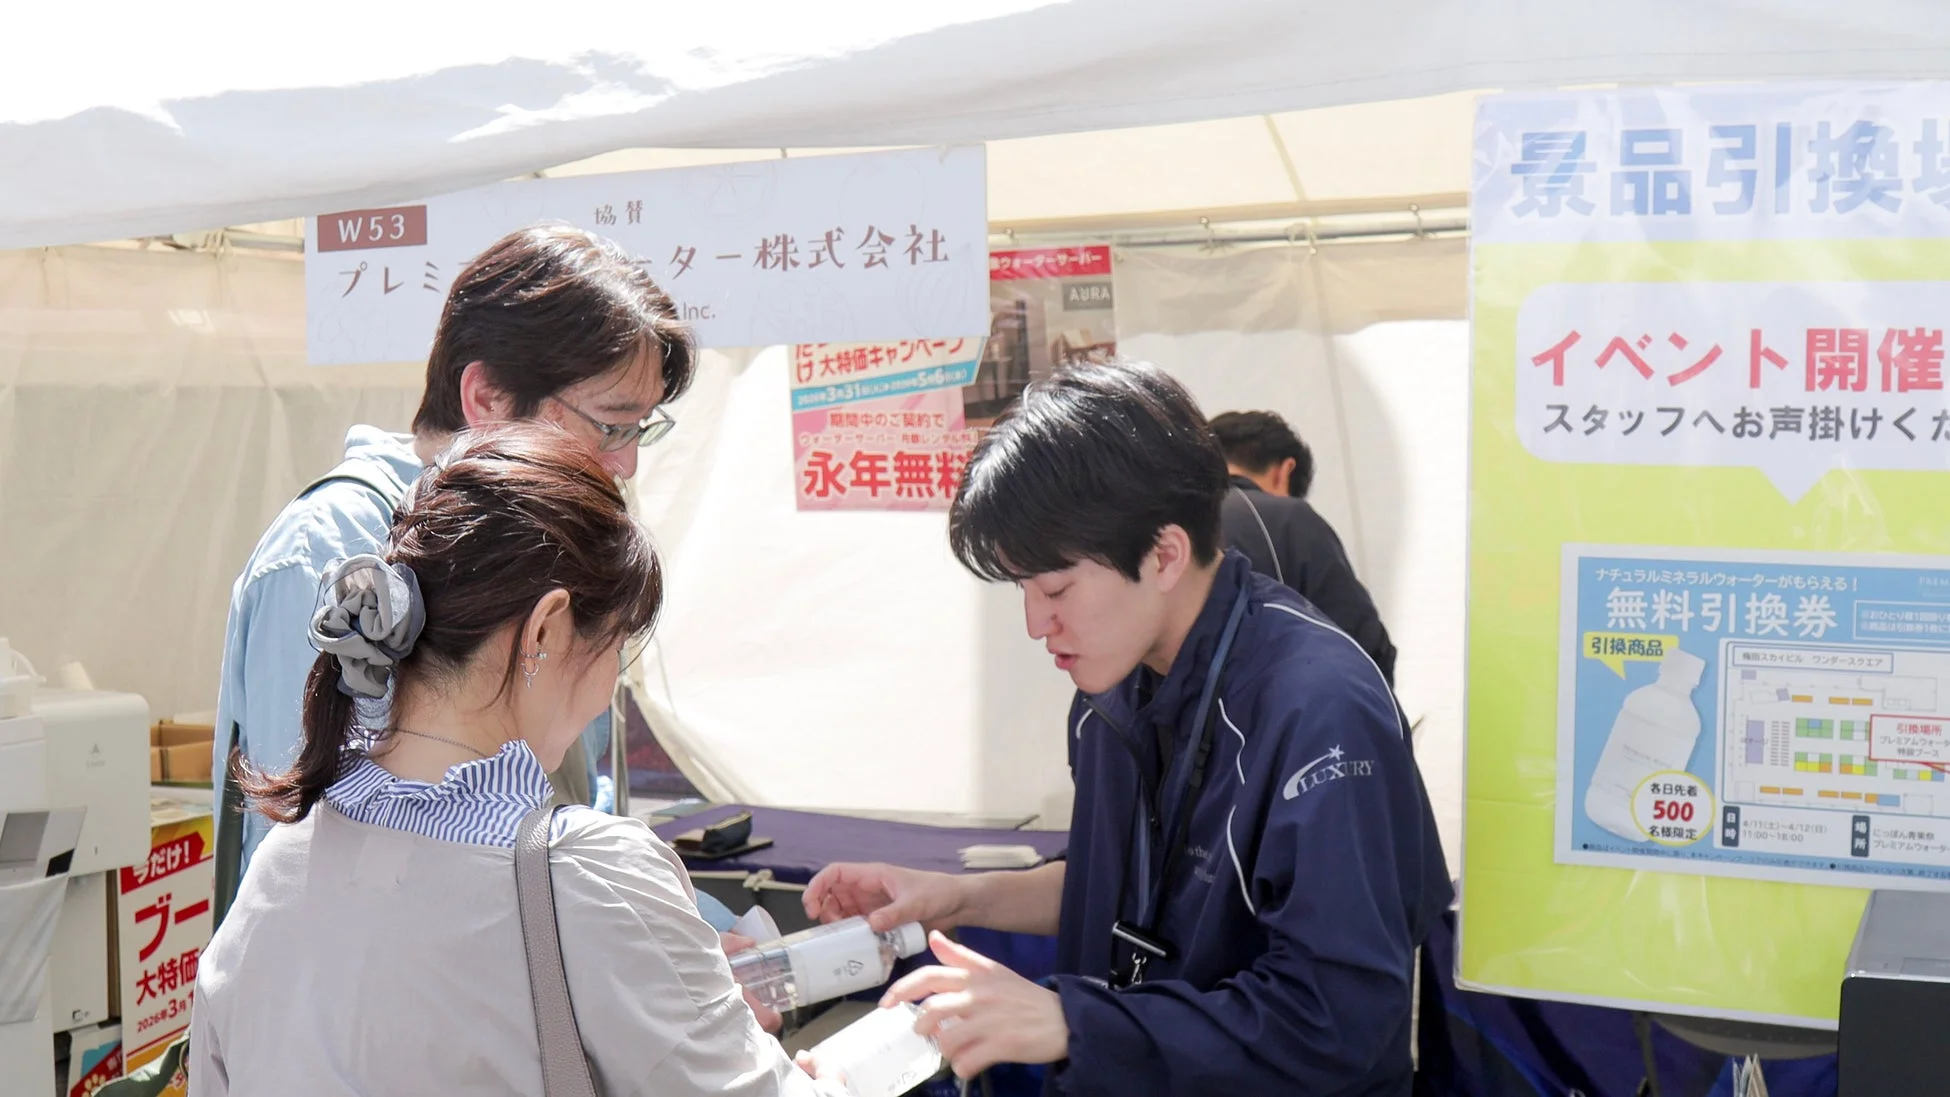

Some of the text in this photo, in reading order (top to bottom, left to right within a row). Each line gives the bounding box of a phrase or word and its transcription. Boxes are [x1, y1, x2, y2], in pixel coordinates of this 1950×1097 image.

[594, 200, 643, 225] 協賛
[338, 214, 405, 243] W53
[338, 223, 950, 300] プレミーター株式会社
[1070, 286, 1110, 302] AURA
[683, 302, 716, 321] Inc.
[1531, 327, 1945, 392] イベント開催
[830, 413, 945, 428] 期間中のご契約で
[1606, 587, 1838, 638] 無料引換券
[1592, 637, 1664, 657] 引換商品
[1299, 760, 1375, 793] LUXURY
[1650, 782, 1698, 797] 各日先着
[1652, 799, 1694, 822] 500
[1649, 825, 1698, 840] 名様限定
[136, 948, 200, 1006] 大特価
